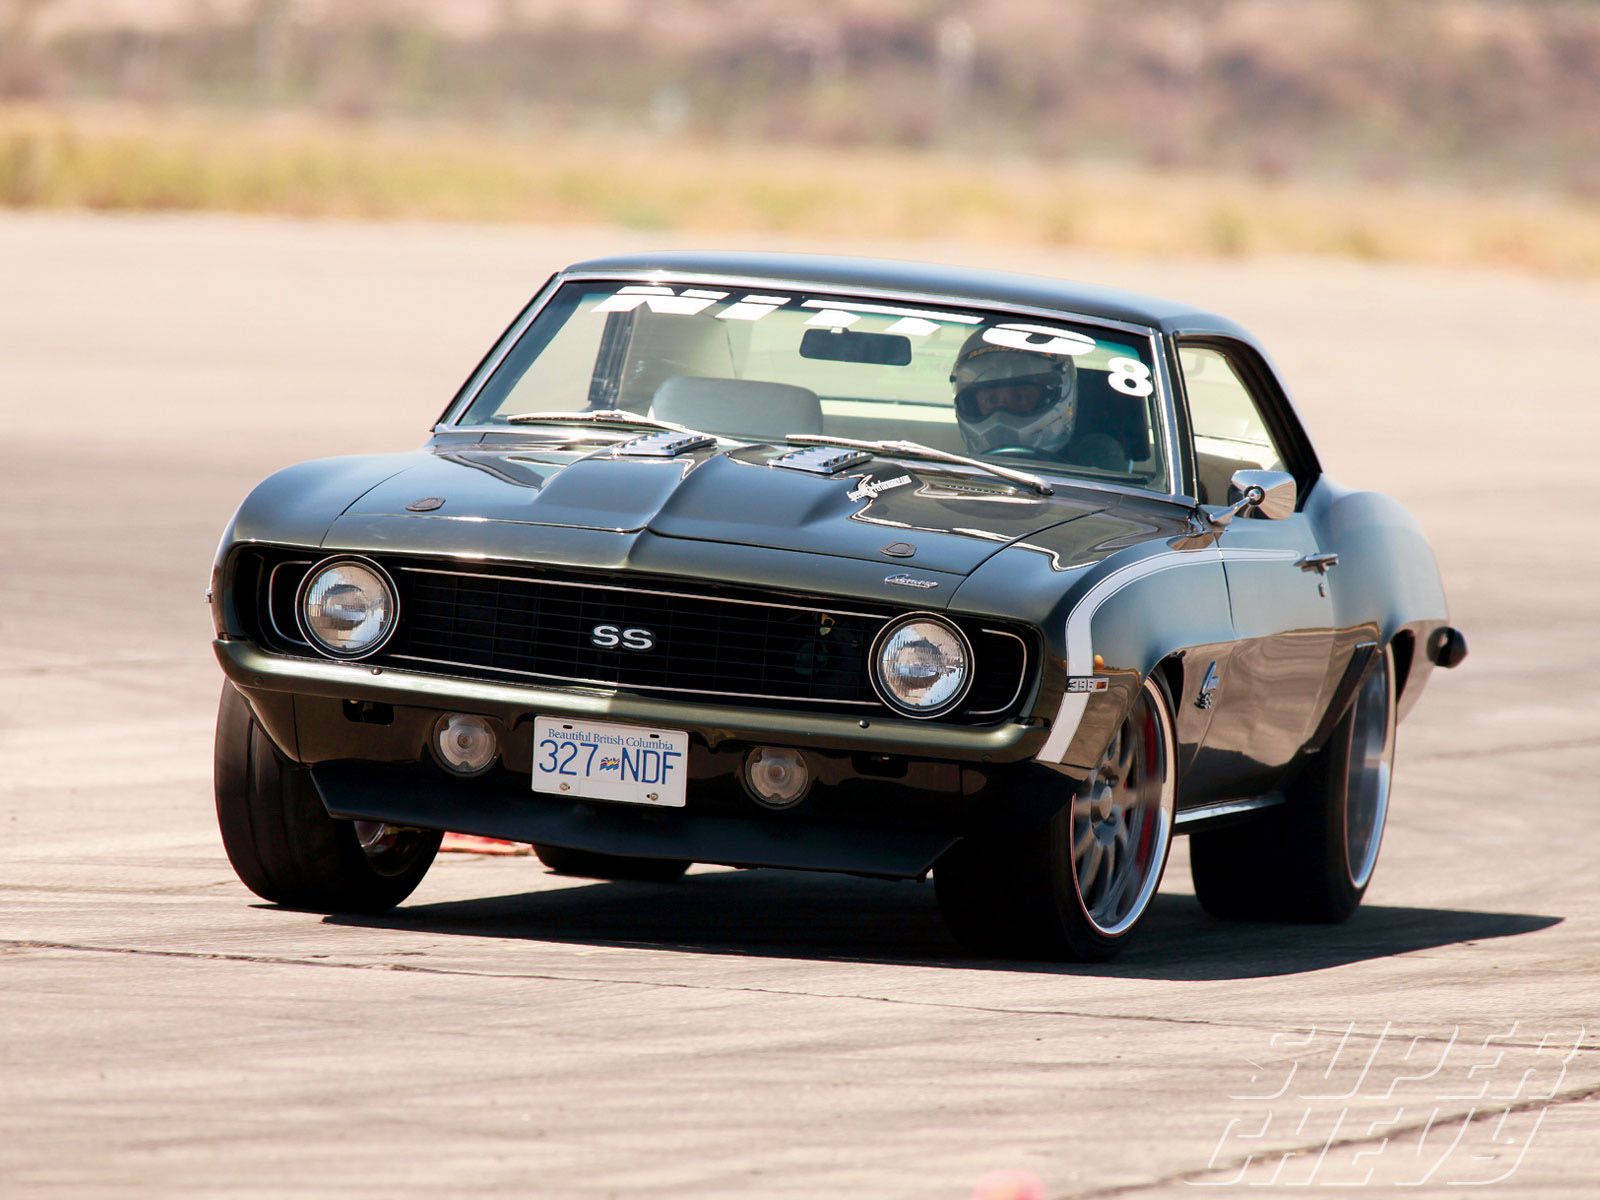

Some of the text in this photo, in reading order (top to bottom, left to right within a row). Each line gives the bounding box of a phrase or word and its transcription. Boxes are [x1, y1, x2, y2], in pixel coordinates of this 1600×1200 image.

[590, 285, 1097, 356] NITTO
[1107, 356, 1154, 397] 8
[592, 625, 653, 650] SS
[548, 728, 673, 751] Beautiful British Columbia
[538, 739, 682, 785] 327 NDF
